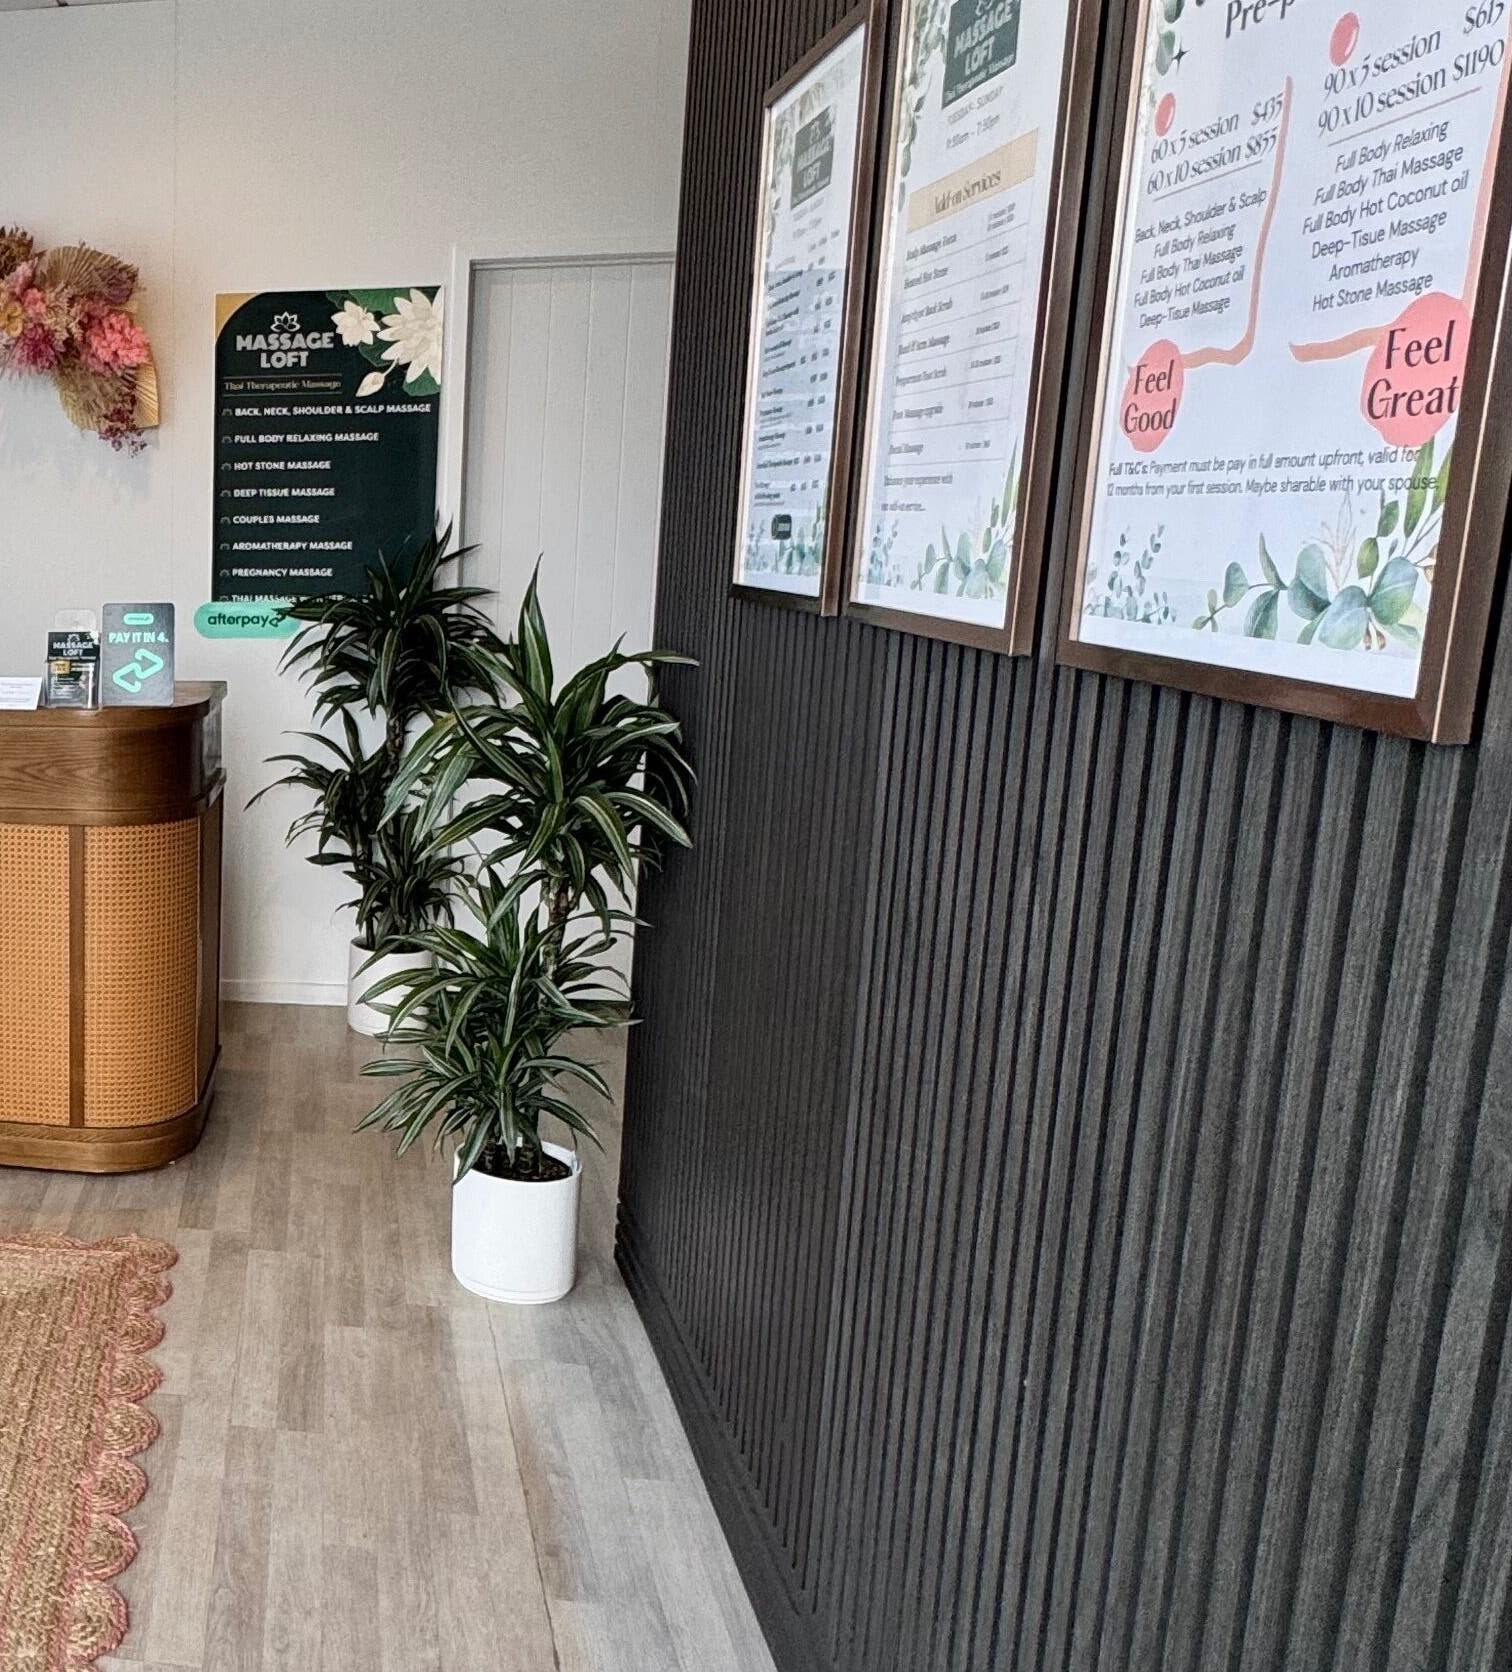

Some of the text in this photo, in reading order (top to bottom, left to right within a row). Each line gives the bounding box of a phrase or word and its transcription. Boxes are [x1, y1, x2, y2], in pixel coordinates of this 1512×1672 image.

[954, 0, 1012, 58] MASSAGE
[965, 36, 995, 76] LOFT
[1372, 30, 1440, 77] session
[1376, 69, 1446, 113] session
[1452, 39, 1505, 82] $1190
[1188, 114, 1240, 149] session
[1335, 121, 1450, 174] Full Body Relaxing
[1190, 145, 1241, 178] session
[1312, 147, 1464, 206] Full Body Thai Massage
[1184, 203, 1226, 227] Shoulder
[1228, 196, 1237, 212] &
[1239, 188, 1267, 209] Scalp
[1302, 169, 1470, 235] Full Body Hot Coconut oil
[1153, 224, 1236, 259] Full Body Relaxing
[1312, 211, 1448, 259] Deep-Tisue Massage
[1141, 245, 1243, 285] Full Body Thai Massage
[1329, 248, 1420, 281] Aromatherapy
[1134, 265, 1245, 307] Full Body Hot Coconut oil
[1312, 273, 1433, 312] Hot Stone Massage
[1139, 297, 1231, 329] Deep-Tisue Massage
[236, 332, 334, 351] MASSAGE
[1385, 320, 1455, 370] Feel
[260, 352, 309, 369] LOFT
[1133, 360, 1174, 395] Feel
[293, 405, 343, 415] SHOULDER
[345, 405, 352, 414] &
[354, 404, 384, 414] SCALP
[386, 404, 431, 413] MASSAGE
[1124, 398, 1176, 434] Good
[1367, 377, 1459, 420] Great
[234, 432, 379, 444] FULL BODY RELAXING MASSAGE
[234, 461, 331, 471] HOT STONE MASSAGE
[1109, 463, 1122, 476] Full
[1149, 460, 1187, 477] Payment
[1189, 459, 1210, 472] must
[1213, 456, 1225, 471] be
[1227, 459, 1246, 475] pay
[1248, 454, 1257, 469] in
[1258, 453, 1274, 469] full
[1274, 452, 1316, 468] amount
[1319, 449, 1364, 470] upfront,
[1368, 447, 1397, 465] valid
[1401, 444, 1421, 463] for
[233, 487, 335, 497] DEEP TISSUE MASSAGE
[1115, 482, 1143, 496] months
[1145, 482, 1165, 495] from
[1166, 483, 1186, 498] your
[1188, 480, 1205, 495] first
[1245, 477, 1277, 497] Maybe
[1280, 475, 1326, 493] sharable
[1329, 474, 1354, 491] with
[1357, 476, 1385, 495] your
[232, 514, 320, 524] COUPLES MASSAGE
[232, 541, 353, 551] AROMATHERAPY MASSAGE
[232, 567, 333, 577] PREGNANCY MASSAGE
[108, 632, 130, 643] PAY
[131, 632, 142, 643] IT
[143, 632, 156, 643] IN
[207, 613, 270, 628] afterpay
[62, 649, 84, 657] LOFT
